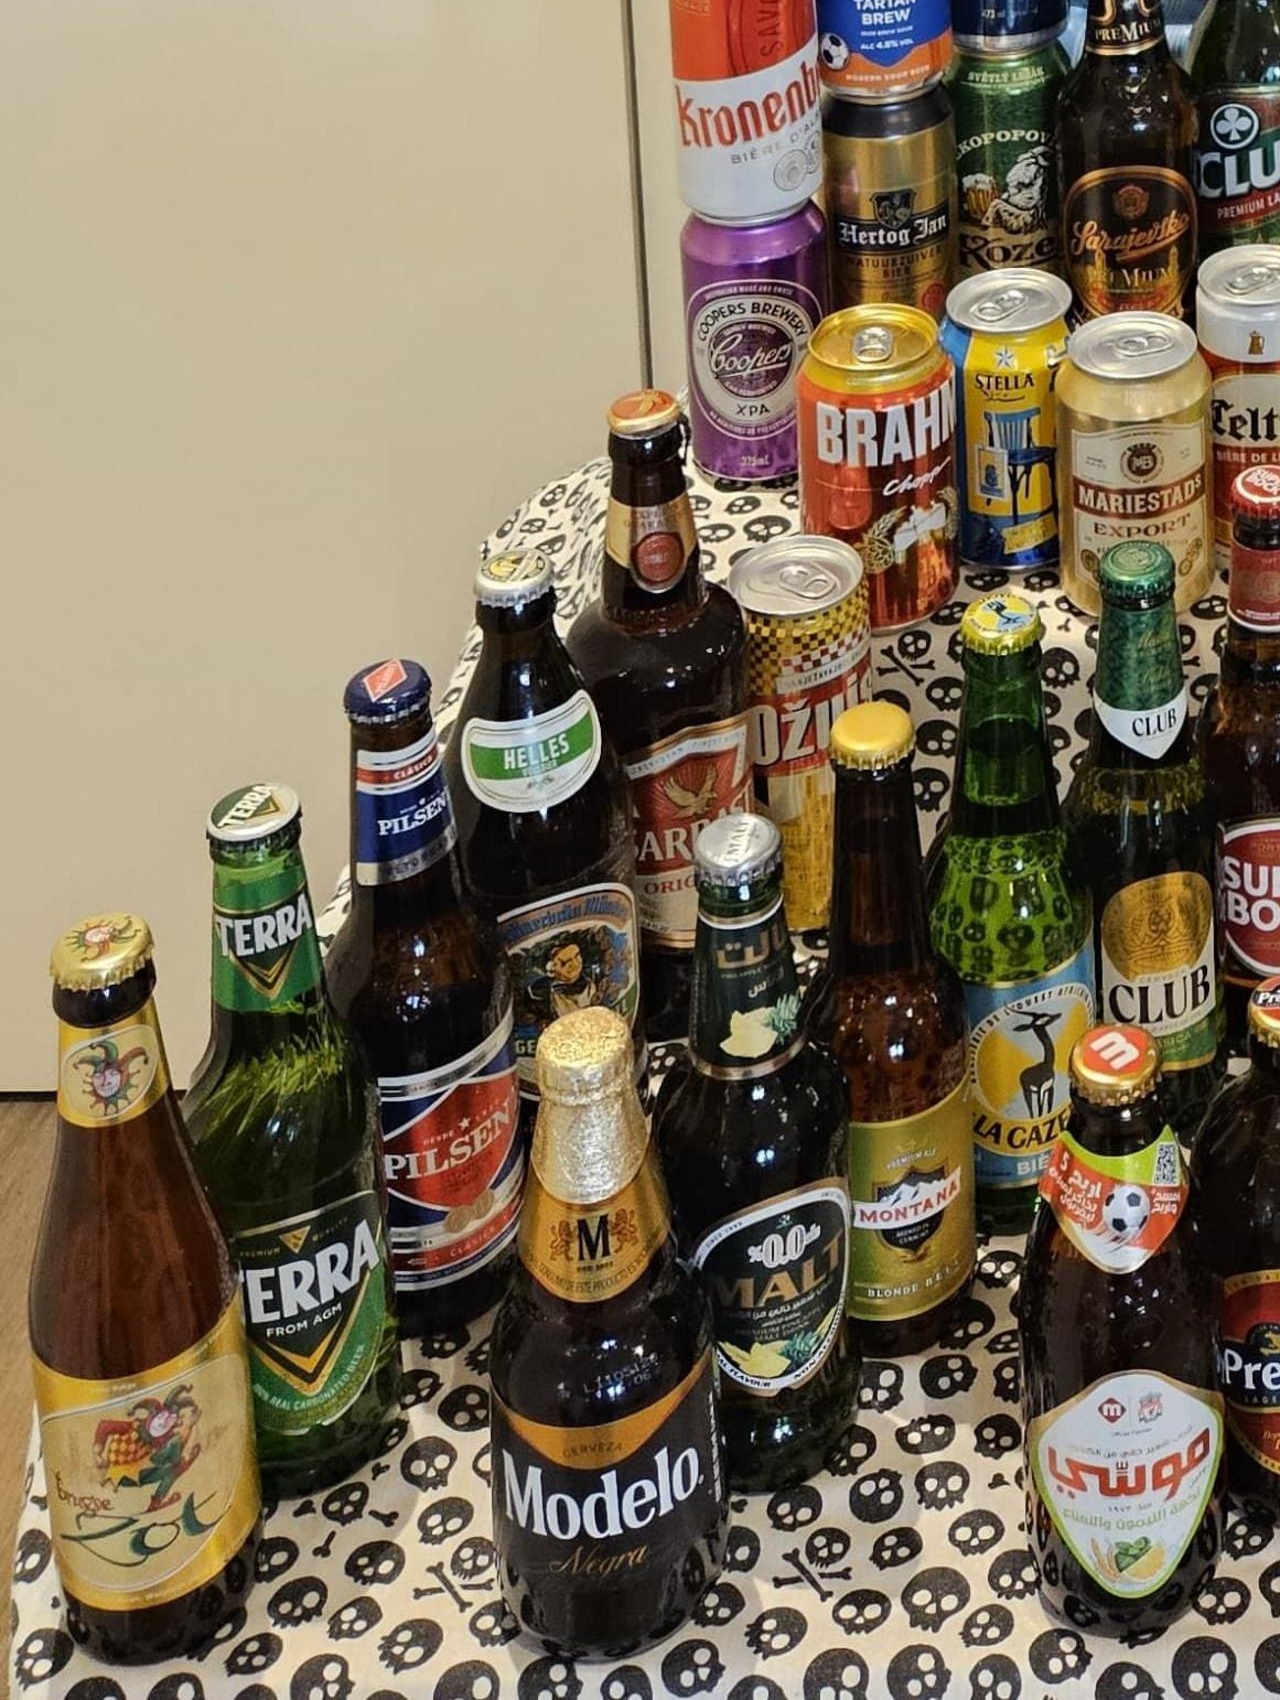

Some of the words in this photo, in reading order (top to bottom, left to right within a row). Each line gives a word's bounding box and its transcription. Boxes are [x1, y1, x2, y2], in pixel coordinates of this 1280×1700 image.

[861, 8, 911, 26] BREW
[1217, 199, 1266, 220] PREMIUM
[839, 221, 911, 247] Hertog
[912, 212, 948, 246] Jan
[698, 301, 747, 343] COOPERS
[750, 301, 809, 337] BREWERY
[709, 332, 794, 374] Coopers
[975, 372, 1035, 391] STELLA
[736, 403, 771, 417] XPA
[882, 455, 951, 497] Chopp
[1250, 451, 1268, 463] DE
[1078, 474, 1203, 514] MARIESTADS
[1093, 514, 1190, 538] EXPORT
[1131, 707, 1177, 738] CLUB
[503, 733, 570, 771] HELLES
[217, 784, 278, 829] TERRA
[378, 790, 450, 837] PILSEN
[213, 892, 313, 958] TERRA
[1108, 964, 1211, 1024] CLUB
[384, 1098, 511, 1180] PILSEN
[973, 1114, 1002, 1145] LA
[859, 1179, 958, 1224] MONTANA
[577, 1213, 612, 1262] M
[867, 1284, 919, 1298] BLONDE
[266, 1318, 308, 1338] FROM
[312, 1302, 343, 1326] AGM
[502, 1446, 700, 1540] Modelo
[550, 1545, 648, 1578] Negra
